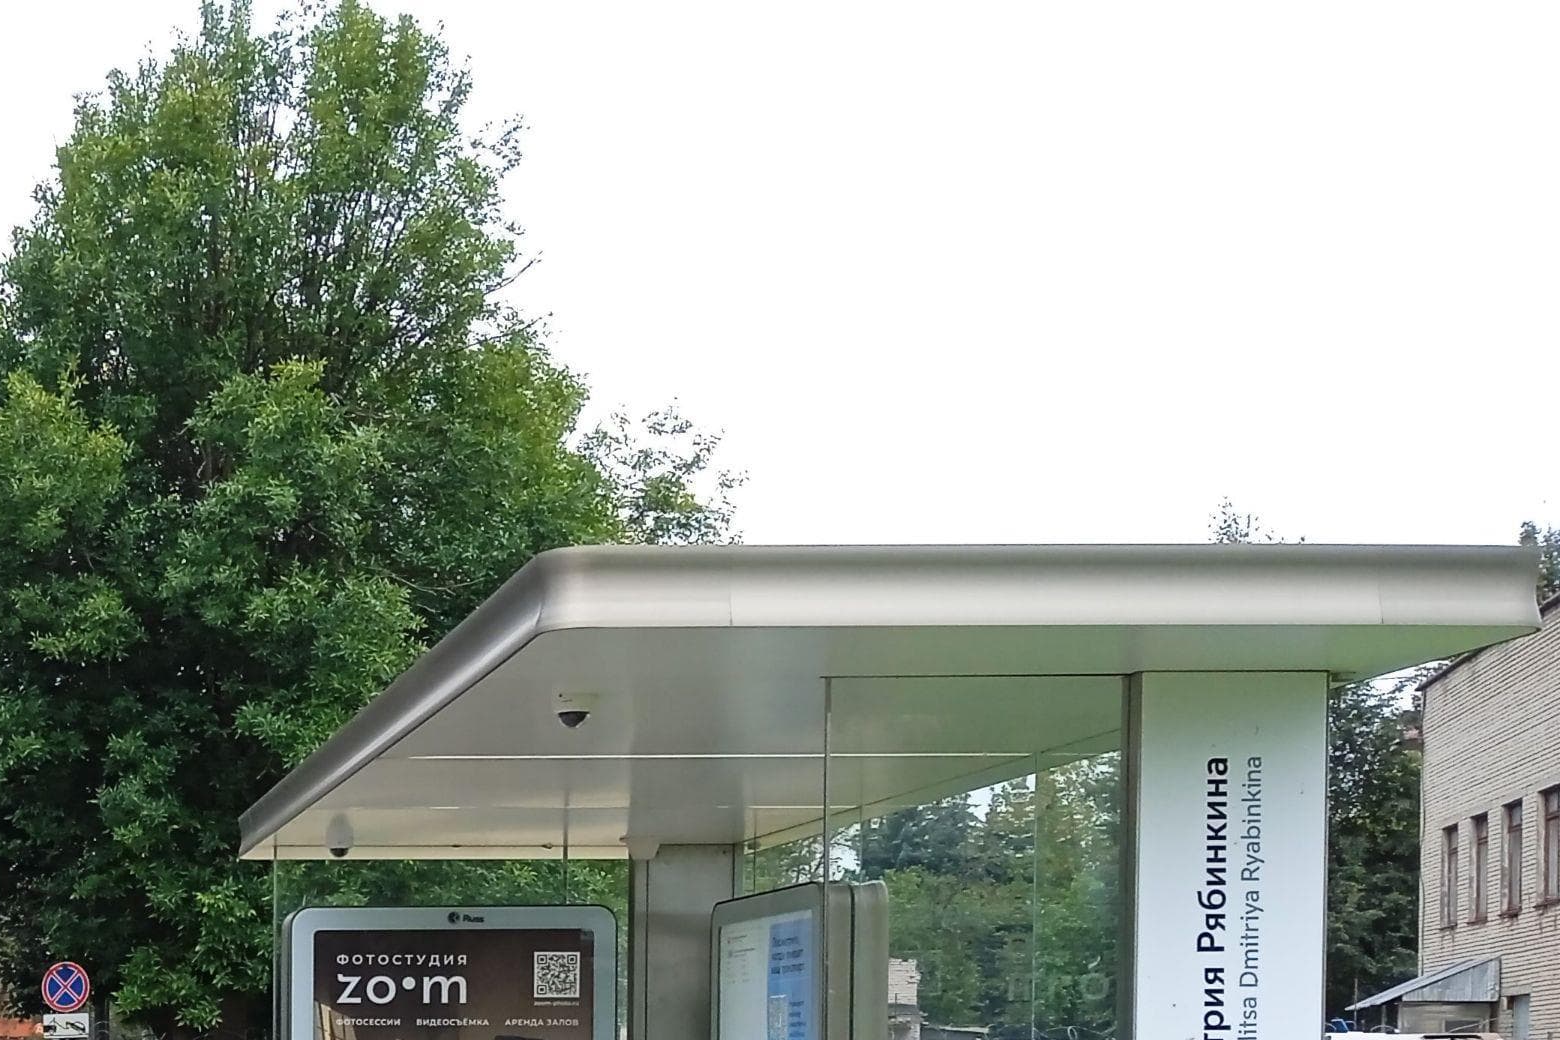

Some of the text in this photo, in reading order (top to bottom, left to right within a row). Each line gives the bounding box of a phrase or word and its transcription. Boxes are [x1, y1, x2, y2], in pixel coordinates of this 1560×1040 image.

[1196, 756, 1230, 952] Рябинкина
[1240, 755, 1265, 881] Ryabinkina
[336, 954, 468, 967] ФОТОСТУДИЯ
[1238, 890, 1264, 987] Dmitriya
[336, 1017, 579, 1027] ФОТОСЕССИИ ВИДЕОСЪЁМКА АРЕНДА ЗАЛОВ
